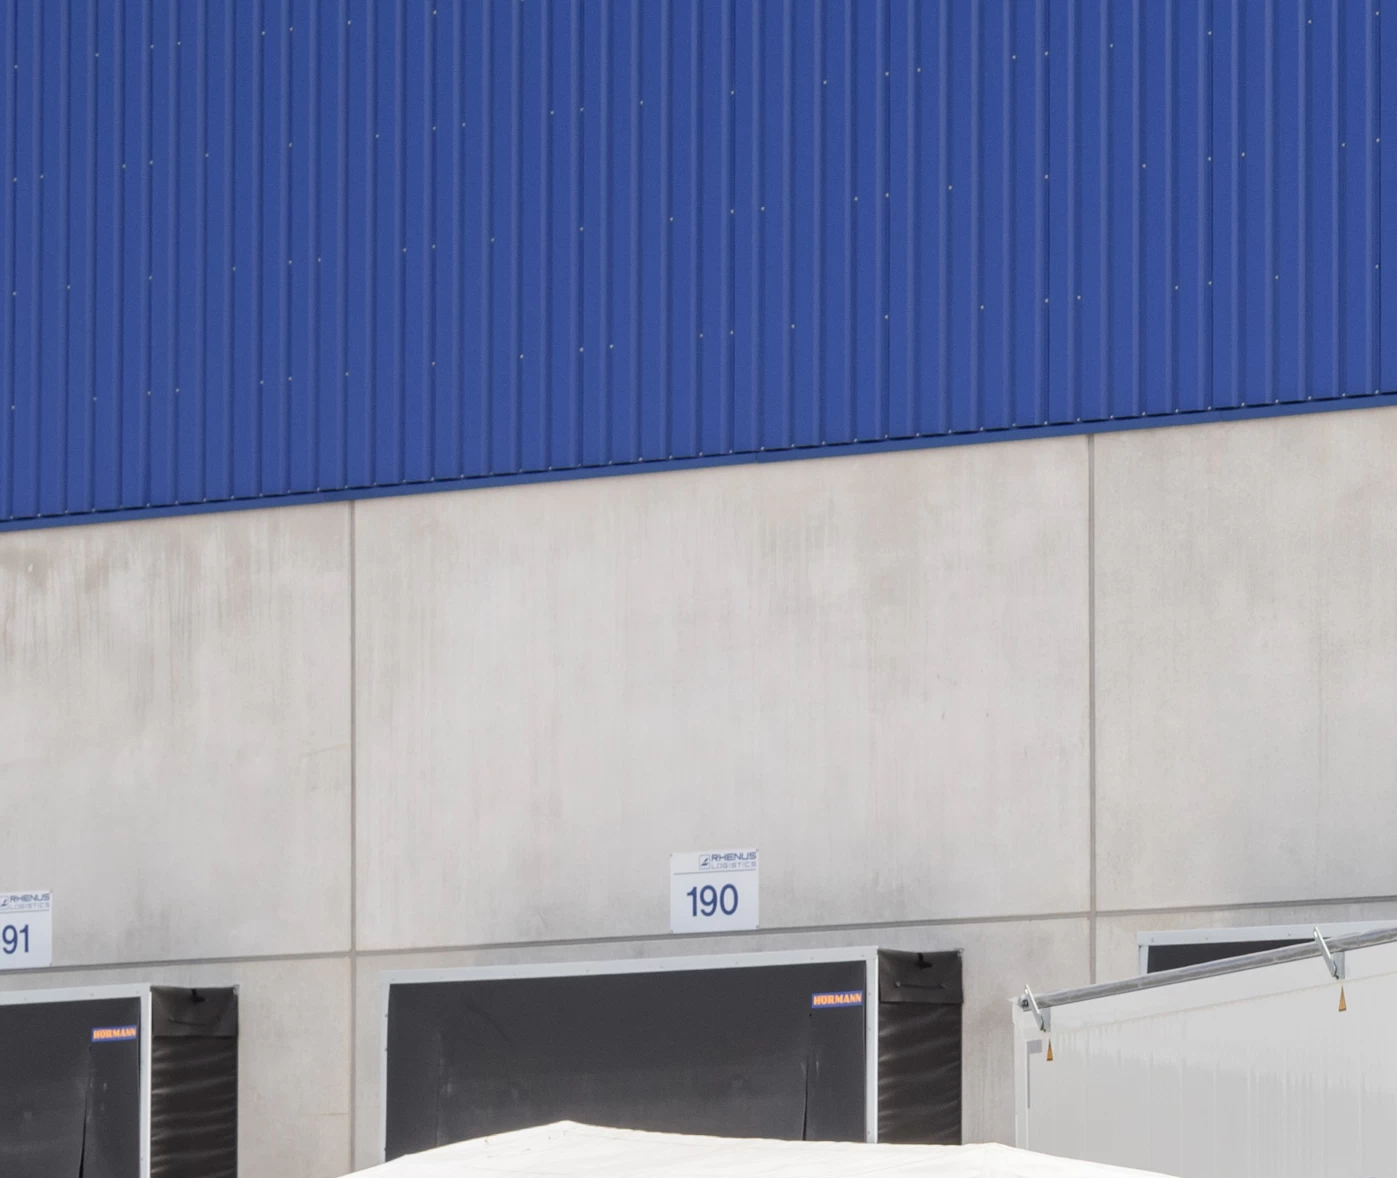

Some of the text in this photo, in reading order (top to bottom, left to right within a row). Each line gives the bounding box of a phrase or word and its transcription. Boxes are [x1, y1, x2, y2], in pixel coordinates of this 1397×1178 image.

[711, 852, 757, 862] RHENUS
[10, 893, 50, 903] RHENUS
[686, 883, 739, 917] 190
[2, 924, 29, 954] 91
